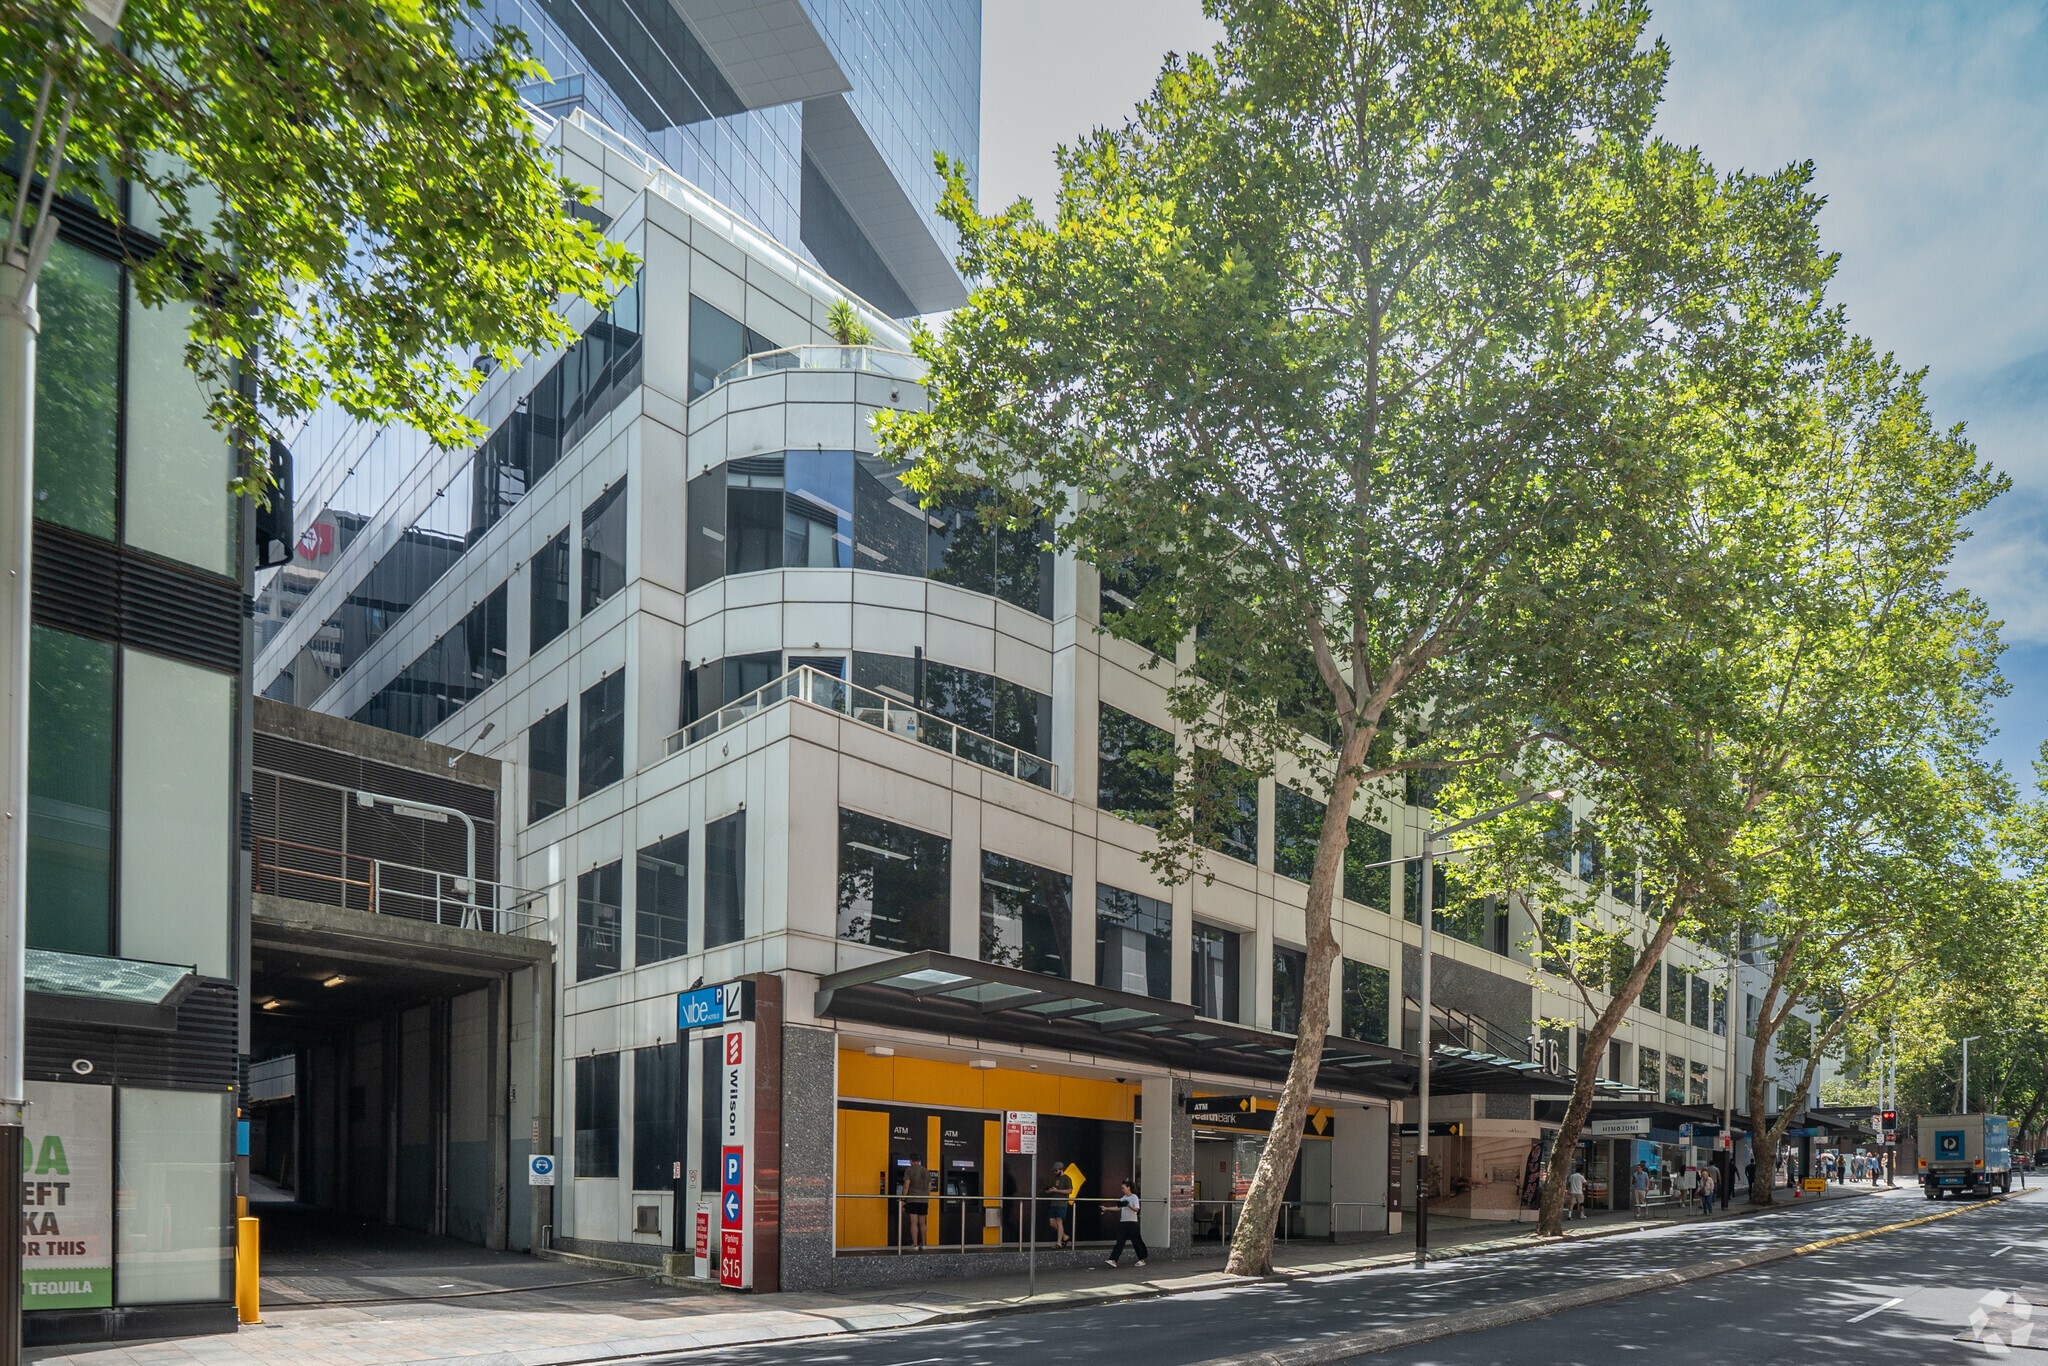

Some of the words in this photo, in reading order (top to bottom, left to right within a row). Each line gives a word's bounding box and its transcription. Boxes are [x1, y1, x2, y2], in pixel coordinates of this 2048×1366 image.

[716, 988, 723, 1003] P
[682, 995, 709, 1023] vibe
[1526, 1034, 1559, 1075] 116
[894, 1126, 909, 1135] ATM
[728, 1158, 738, 1179] P
[724, 1234, 740, 1245] Parking
[46, 1241, 86, 1256] THIS
[727, 1246, 737, 1254] from
[722, 1257, 740, 1279] $15
[29, 1280, 93, 1295] TEQUILA
